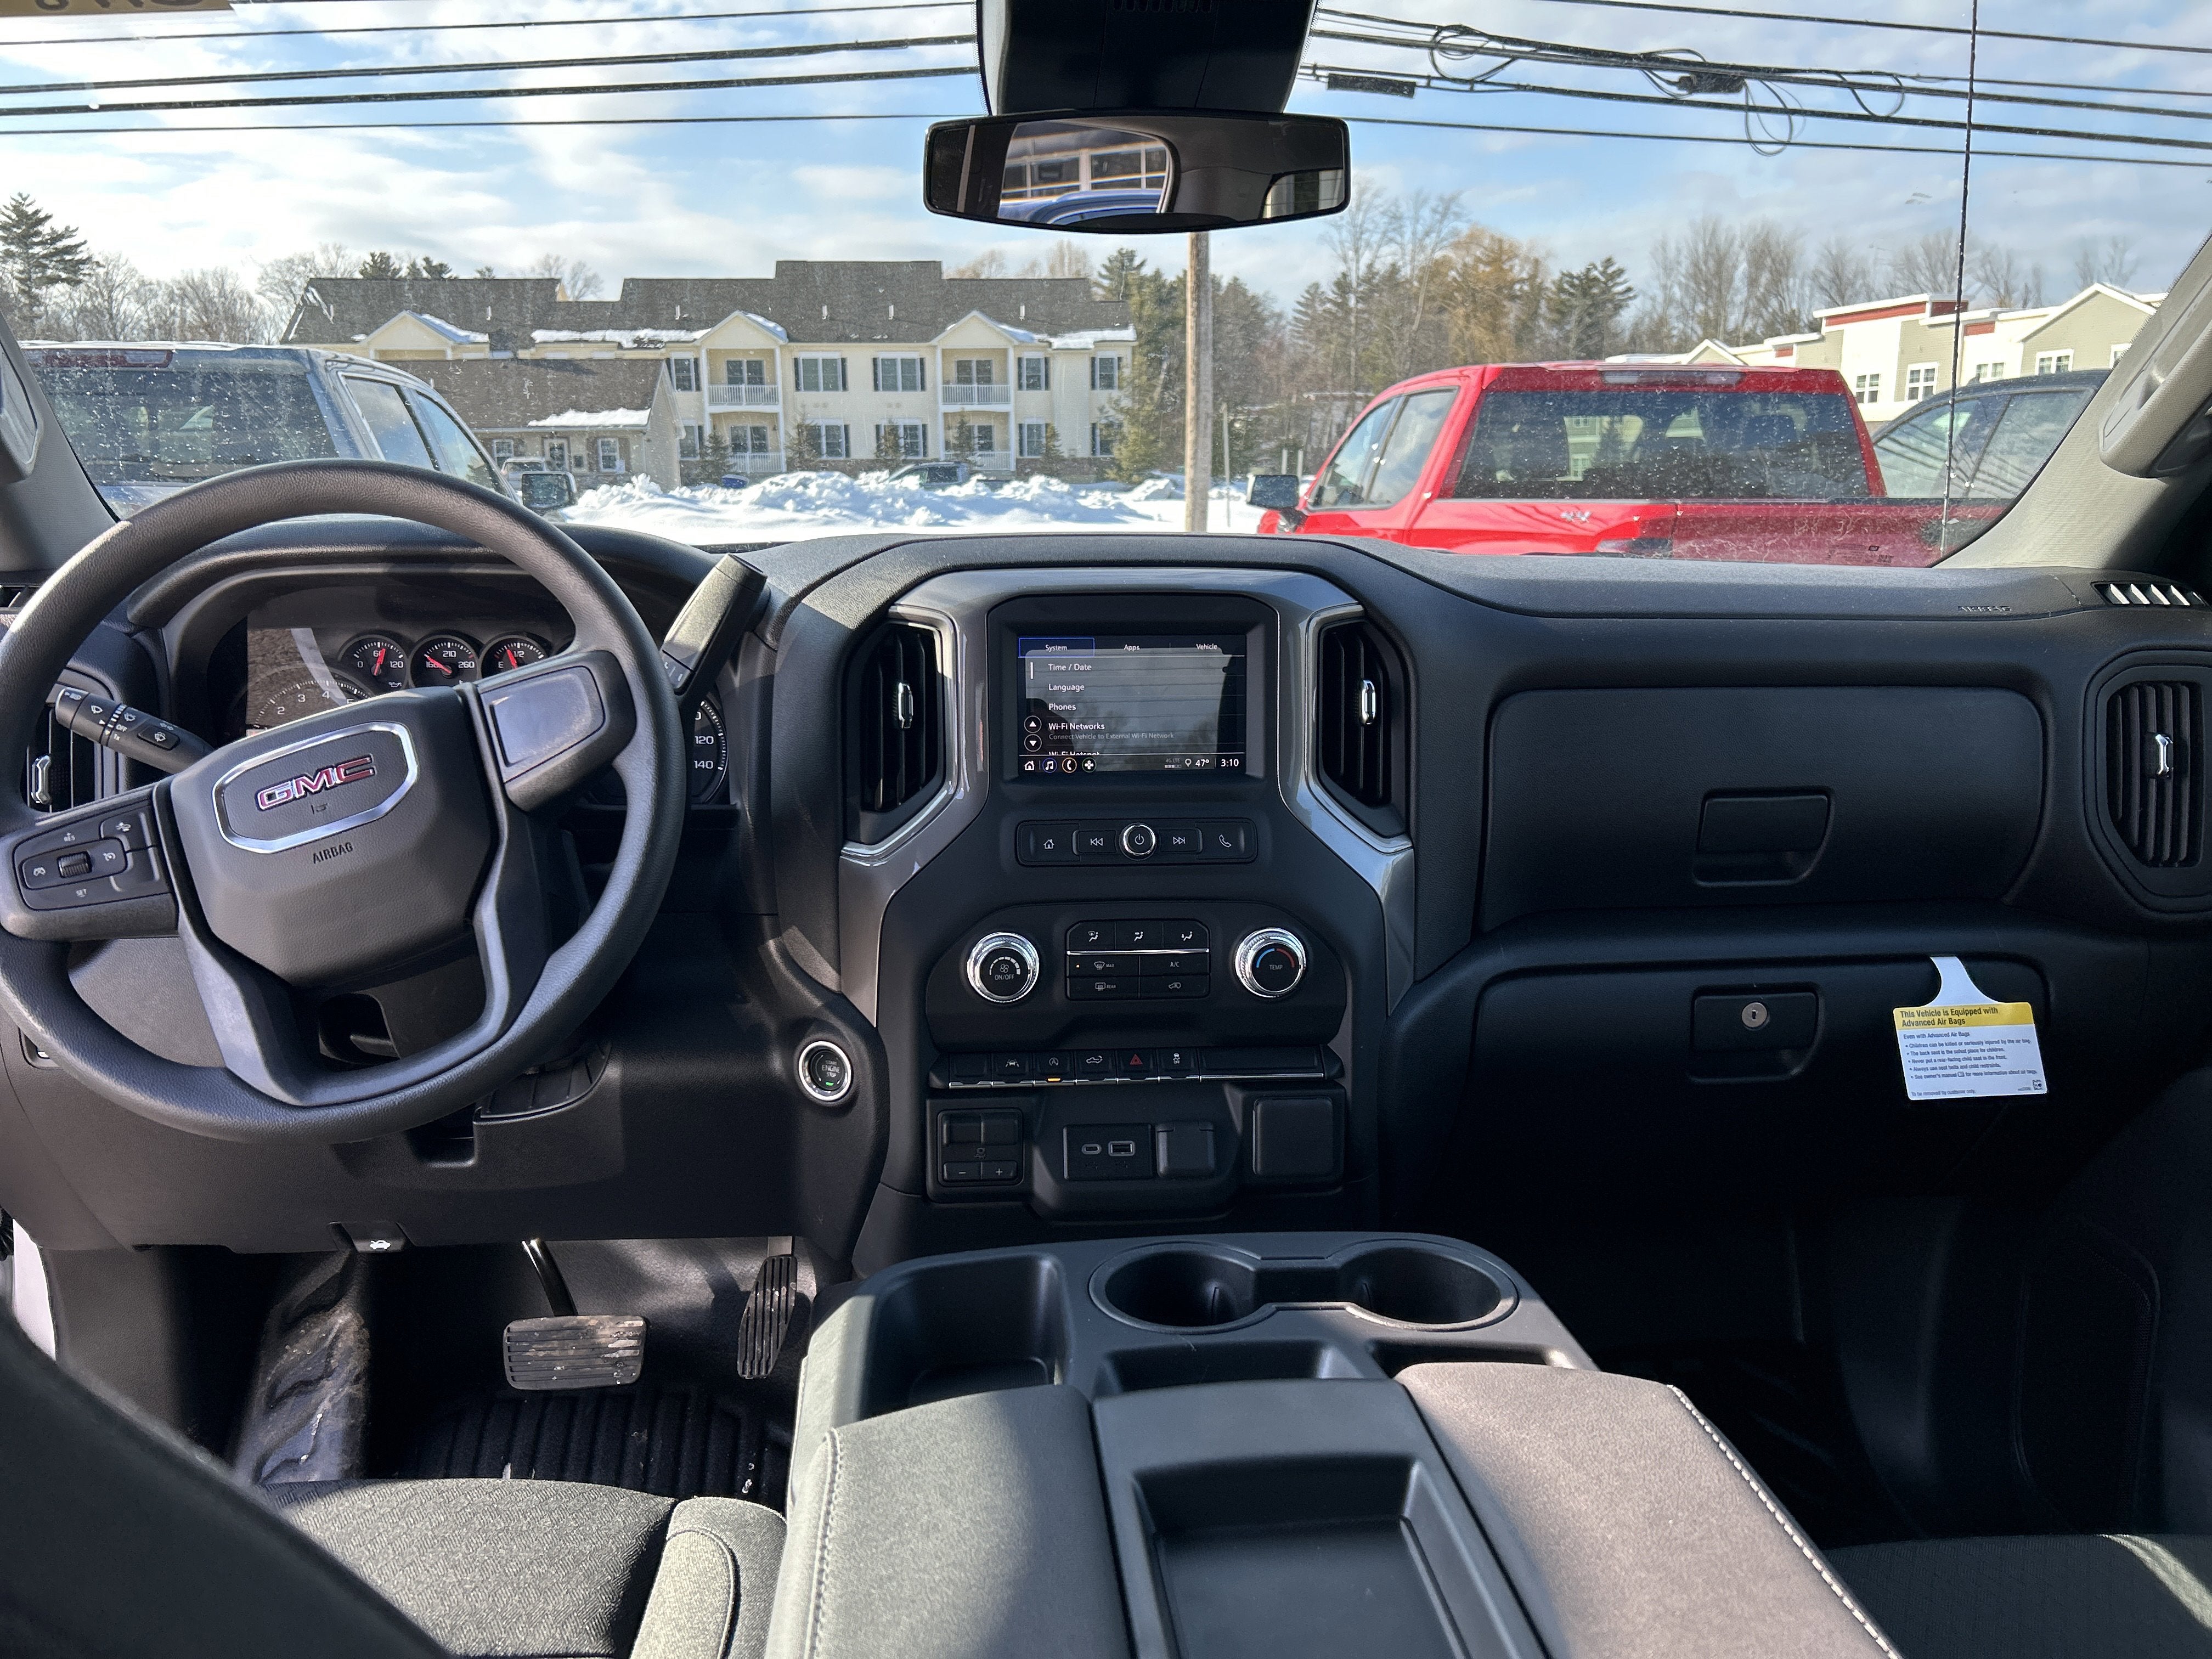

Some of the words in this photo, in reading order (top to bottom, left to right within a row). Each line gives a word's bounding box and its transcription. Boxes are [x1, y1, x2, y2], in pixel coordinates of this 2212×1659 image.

[1045, 644, 1068, 652] System
[1048, 684, 1085, 692] Language
[298, 694, 306, 702] 3
[322, 691, 329, 699] 4
[277, 707, 285, 715] 2
[116, 724, 127, 732] OFF
[695, 736, 714, 744] 120
[694, 760, 713, 769] 140
[1221, 759, 1239, 767] 3:10
[256, 754, 377, 811] GMC
[313, 842, 353, 864] AIRBAG
[1900, 1010, 1915, 1018] This
[1916, 1009, 1941, 1018] Vehicle
[1950, 1007, 1982, 1017] Equipped
[1902, 1019, 1935, 1027] Advanced
[1948, 1018, 1966, 1026] Bags
[822, 1064, 840, 1073] ENGINE
